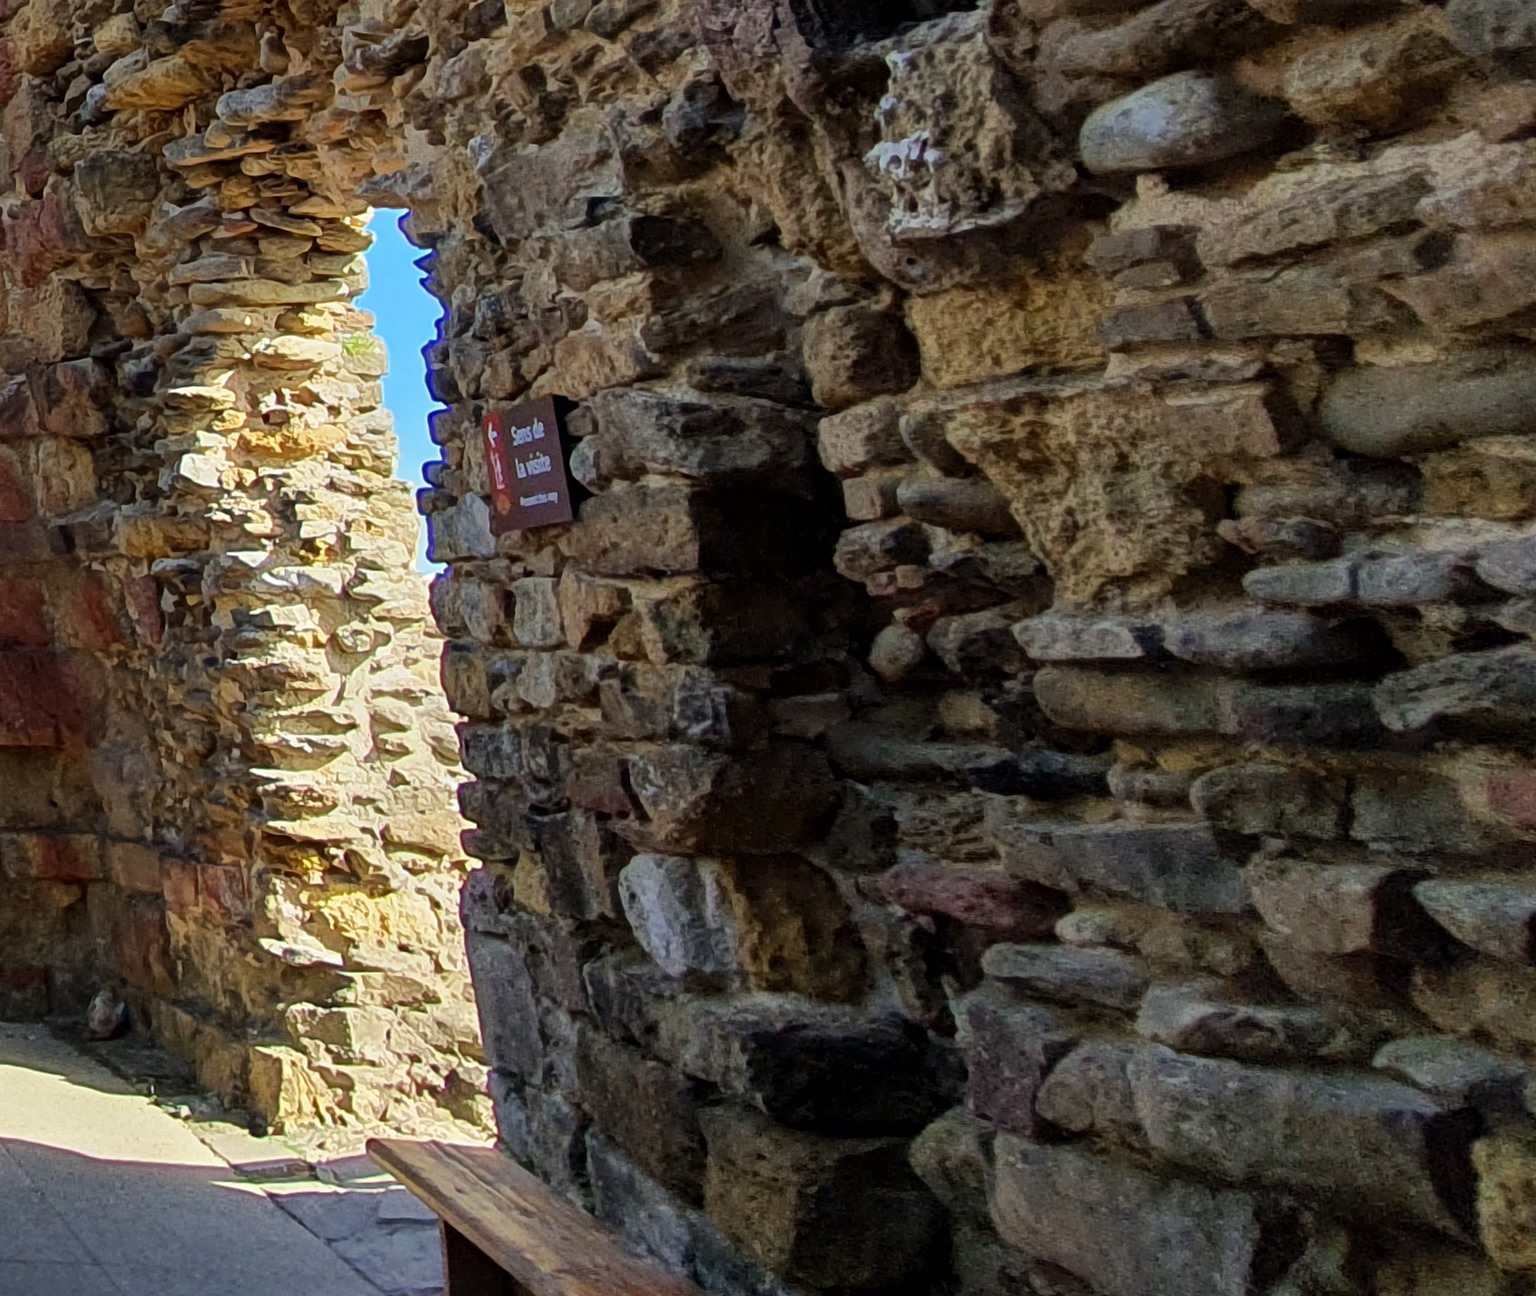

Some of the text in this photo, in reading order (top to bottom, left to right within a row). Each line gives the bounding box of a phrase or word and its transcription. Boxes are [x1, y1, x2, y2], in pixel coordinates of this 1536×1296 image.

[510, 416, 545, 446] Sens de
[514, 451, 552, 479] la visite
